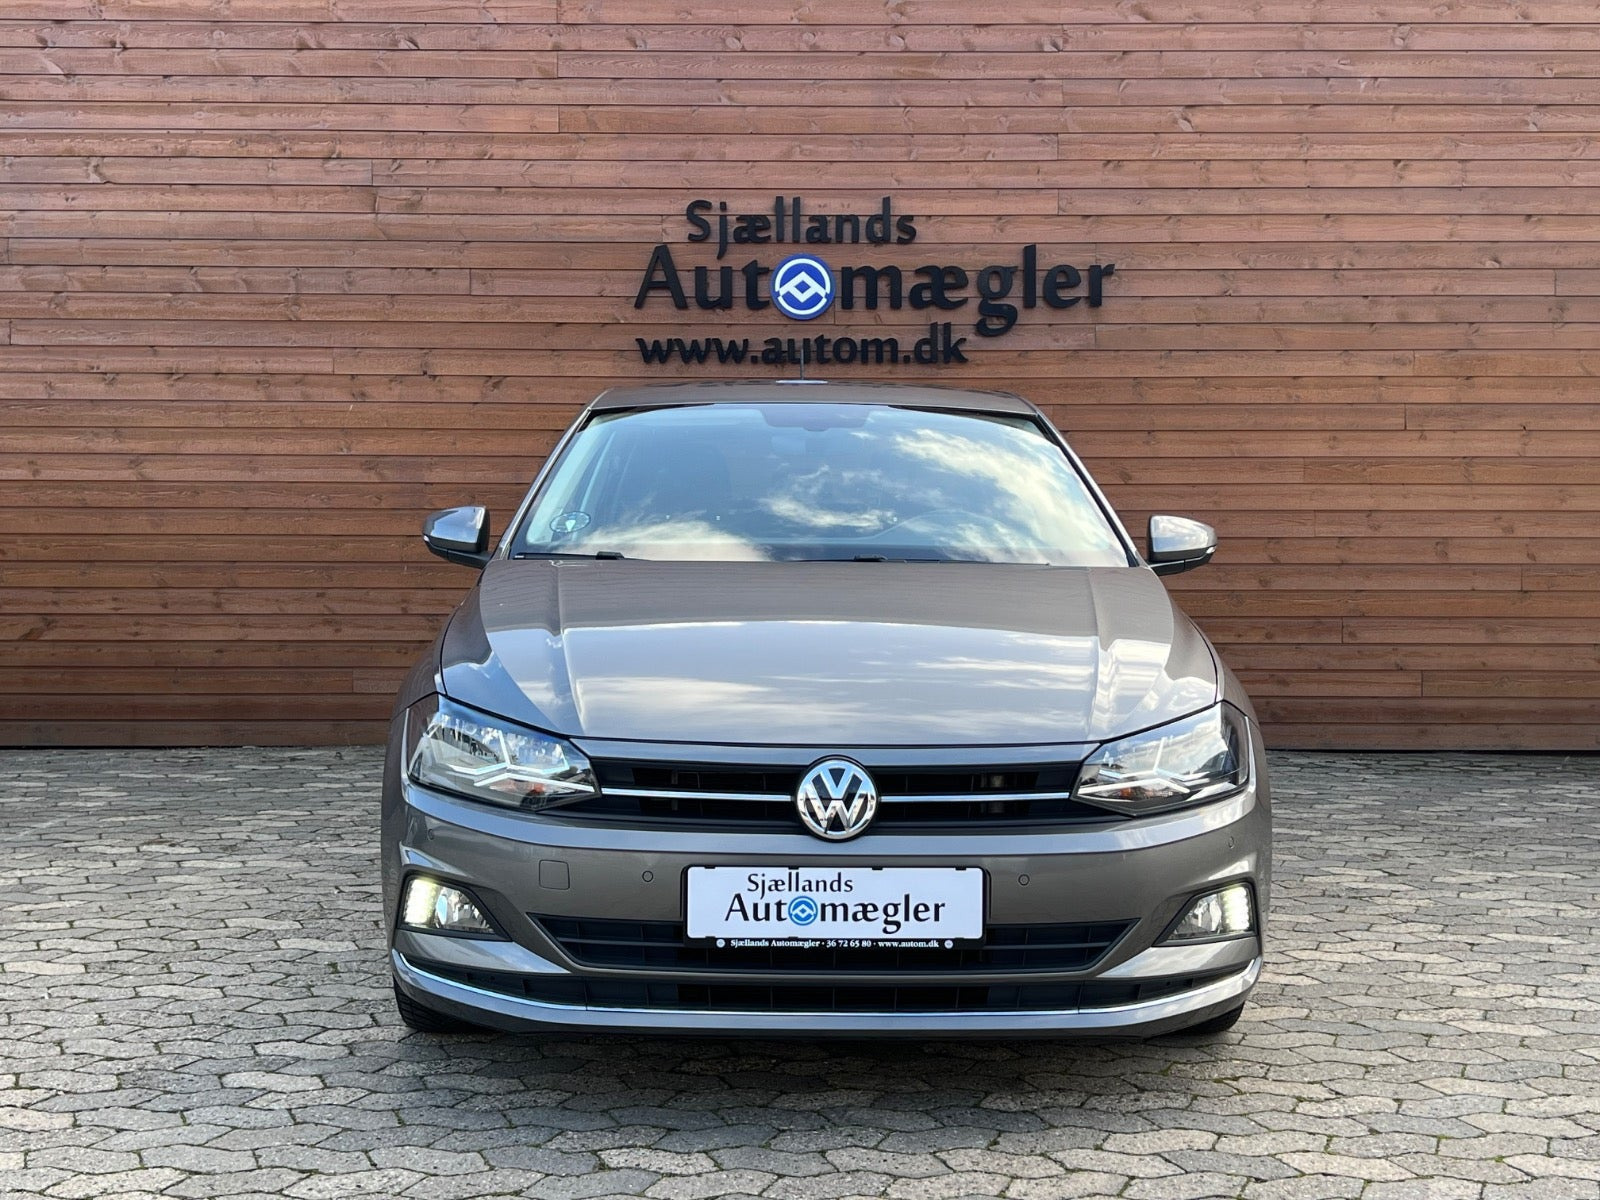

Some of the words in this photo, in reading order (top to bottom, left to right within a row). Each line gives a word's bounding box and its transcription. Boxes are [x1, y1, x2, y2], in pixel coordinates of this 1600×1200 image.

[686, 196, 918, 260] Sjællands
[634, 321, 969, 366] www.autom.dk
[746, 871, 854, 899] Sjællands
[730, 938, 769, 948] Sjællands
[770, 938, 820, 949] Automægler
[826, 939, 837, 948] 36
[838, 939, 849, 948] 72
[850, 939, 860, 948] 65
[861, 939, 872, 948] 80
[877, 939, 940, 949] www.autom.dk
